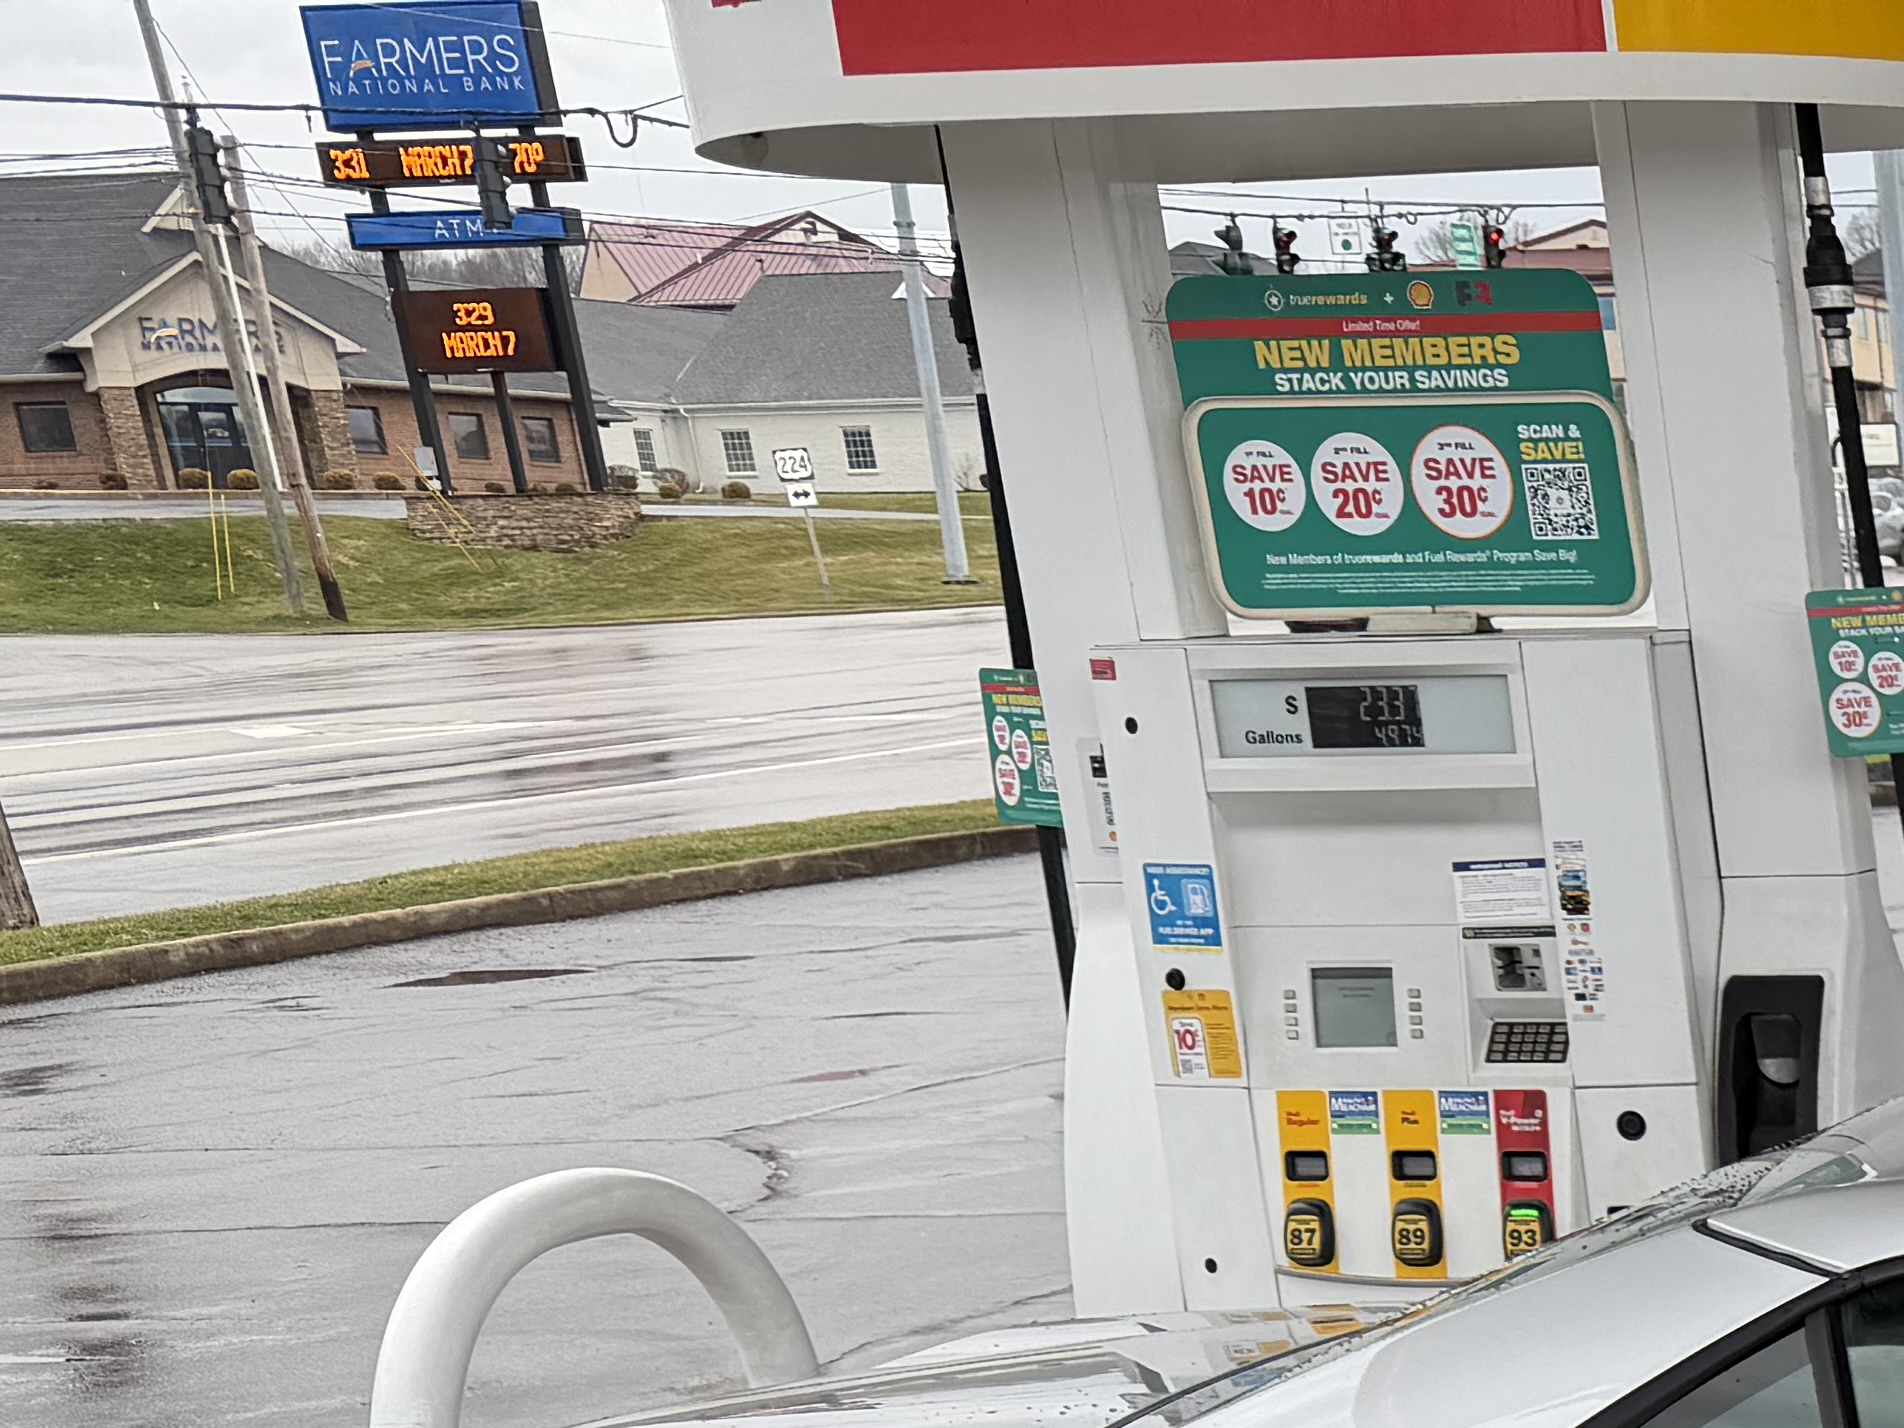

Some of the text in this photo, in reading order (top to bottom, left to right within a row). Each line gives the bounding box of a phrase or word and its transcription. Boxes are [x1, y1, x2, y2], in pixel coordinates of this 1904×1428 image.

[319, 35, 520, 78] FARMERS
[329, 75, 525, 96] NATIONAL BANK
[399, 146, 462, 178] MARCH
[434, 219, 484, 240] ATM
[442, 330, 516, 358] MARCH 7
[1253, 335, 1520, 369] NEW MEMBERS
[1274, 368, 1509, 391] STACK YOUR SAVINGS
[1517, 424, 1581, 439] SCAN &
[1519, 441, 1585, 461] SAVE!
[779, 455, 808, 473] 224
[1231, 464, 1294, 484] SAVE
[1320, 461, 1391, 484] SAVE
[1423, 457, 1496, 481] SAVE
[1243, 487, 1287, 516] 10¢
[1332, 487, 1383, 519] 20¢
[1434, 485, 1489, 519] 30¢
[1831, 616, 1862, 630] NEW
[1835, 696, 1873, 710] SAVE
[1245, 730, 1303, 745] Gallons
[1290, 1228, 1317, 1246] 87
[1399, 1228, 1426, 1246] 89
[1508, 1229, 1538, 1247] 93
